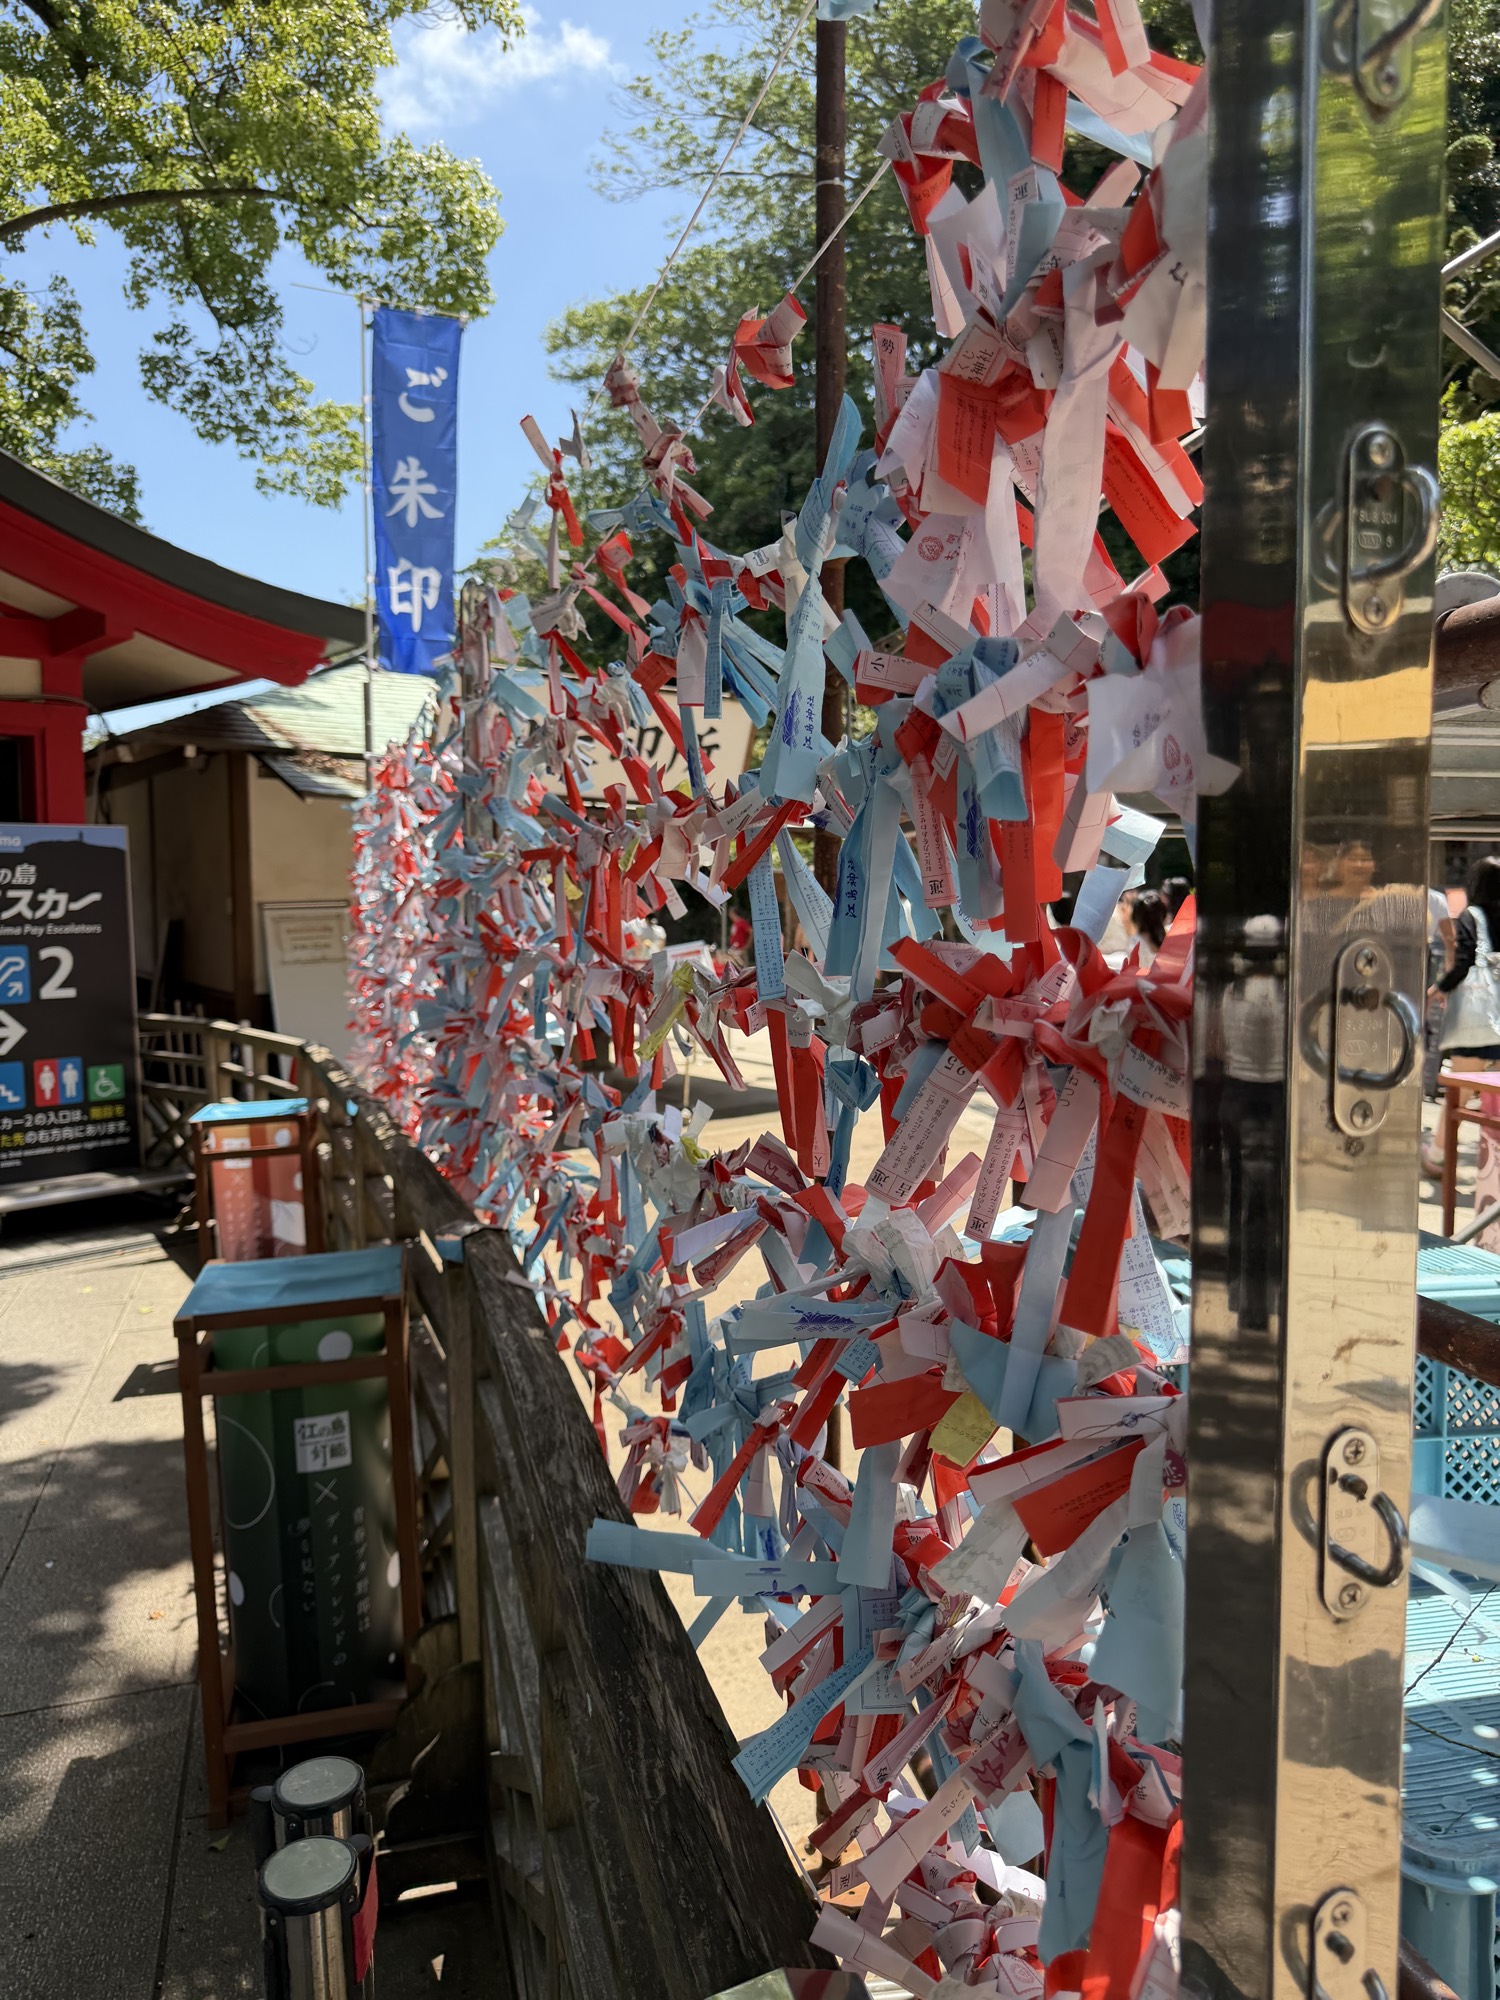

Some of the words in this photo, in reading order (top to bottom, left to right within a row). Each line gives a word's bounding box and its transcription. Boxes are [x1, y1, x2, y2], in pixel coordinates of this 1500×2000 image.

[385, 365, 450, 634] ご朱印
[0, 887, 103, 921] スカー
[38, 945, 77, 1000] 2
[870, 1168, 890, 1188] 運
[895, 1182, 912, 1198] 吉
